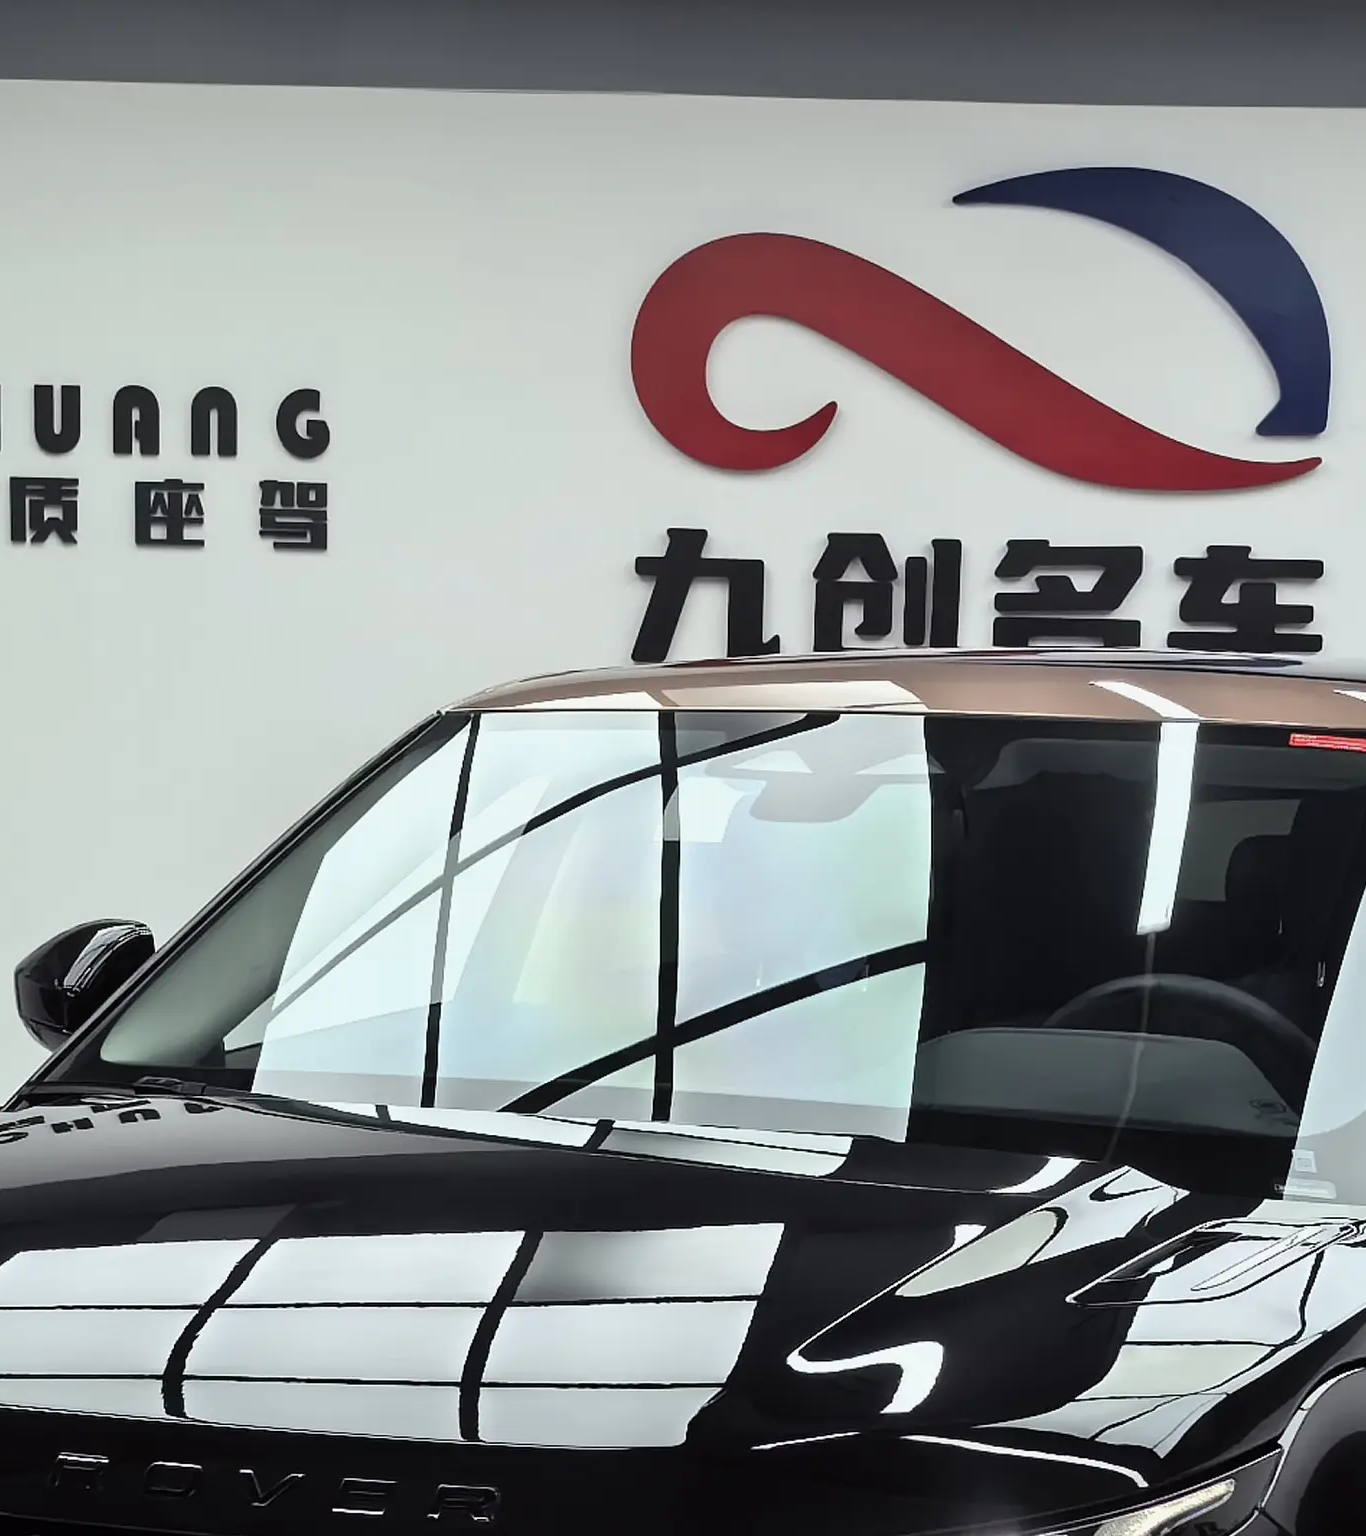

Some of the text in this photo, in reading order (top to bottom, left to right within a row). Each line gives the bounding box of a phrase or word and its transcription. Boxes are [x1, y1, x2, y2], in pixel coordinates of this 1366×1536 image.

[630, 527, 1325, 663] 九创名车
[48, 1451, 501, 1522] ROVER
